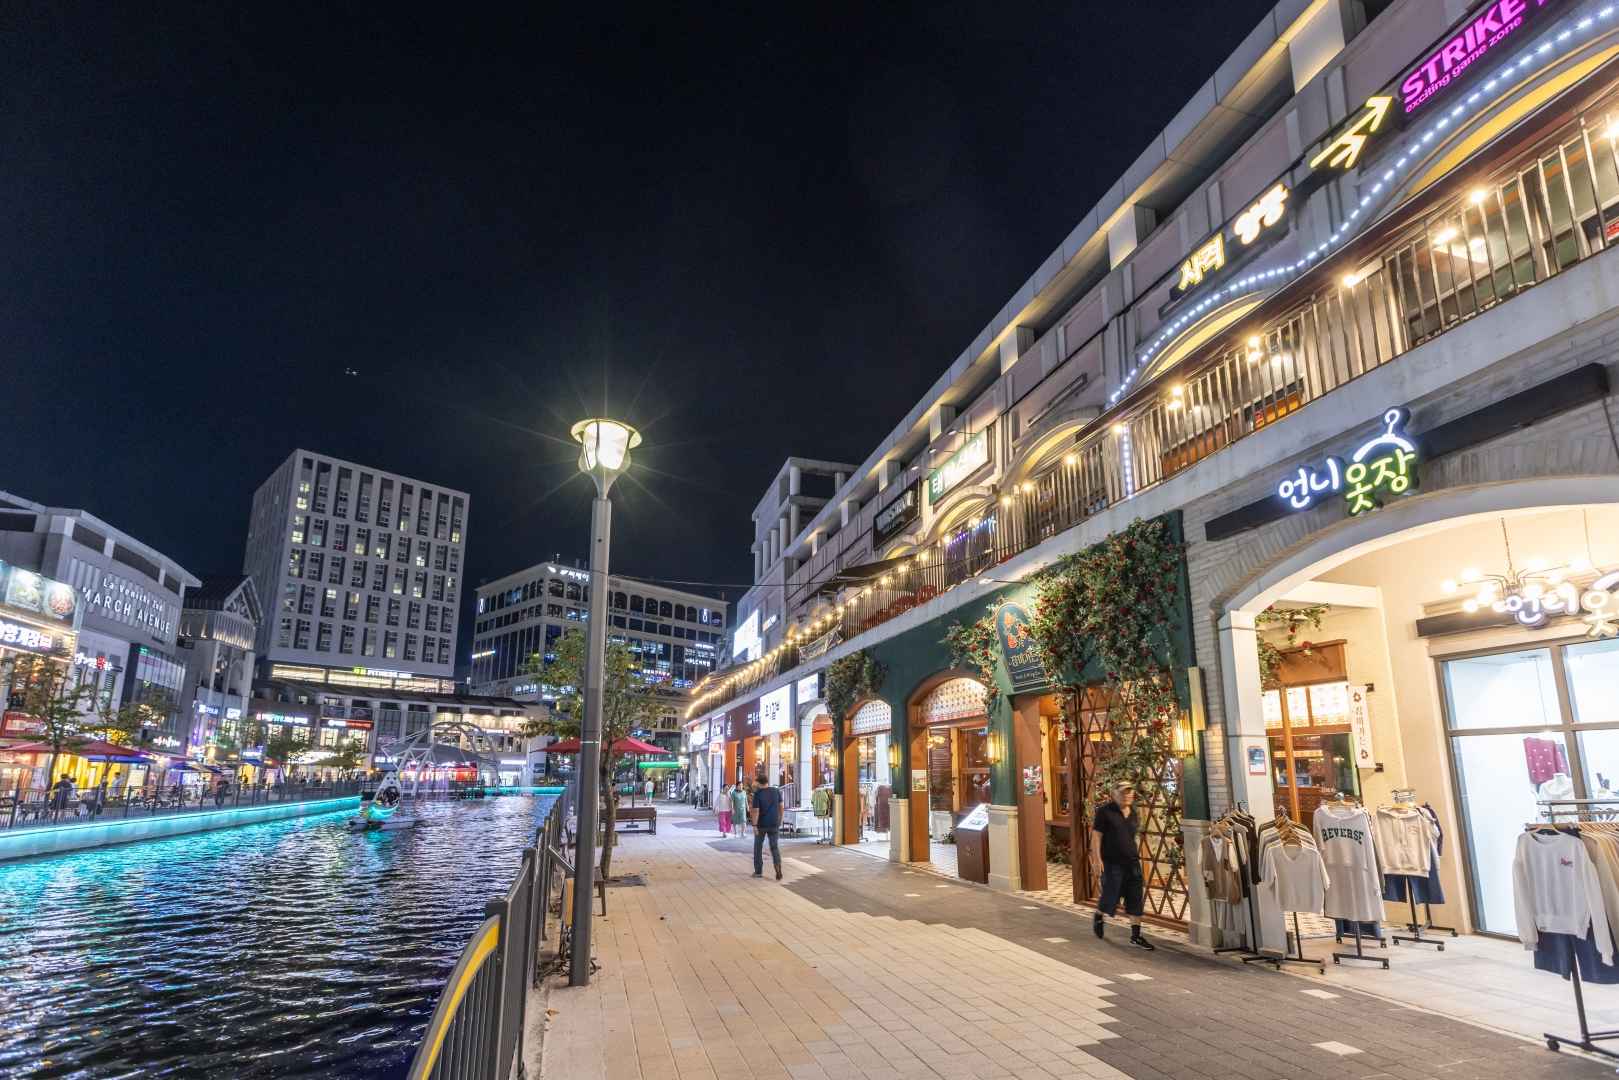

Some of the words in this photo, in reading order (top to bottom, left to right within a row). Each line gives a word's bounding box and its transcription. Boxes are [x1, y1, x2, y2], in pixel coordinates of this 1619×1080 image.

[1402, 0, 1526, 104] STRIKE
[1405, 74, 1450, 113] exciting
[1452, 44, 1488, 76] game
[1489, 16, 1523, 46] zone
[1278, 457, 1340, 509] 언니
[1345, 448, 1417, 516] 옷장
[137, 609, 171, 634] AVENUE
[1320, 827, 1365, 846] REVERSE
